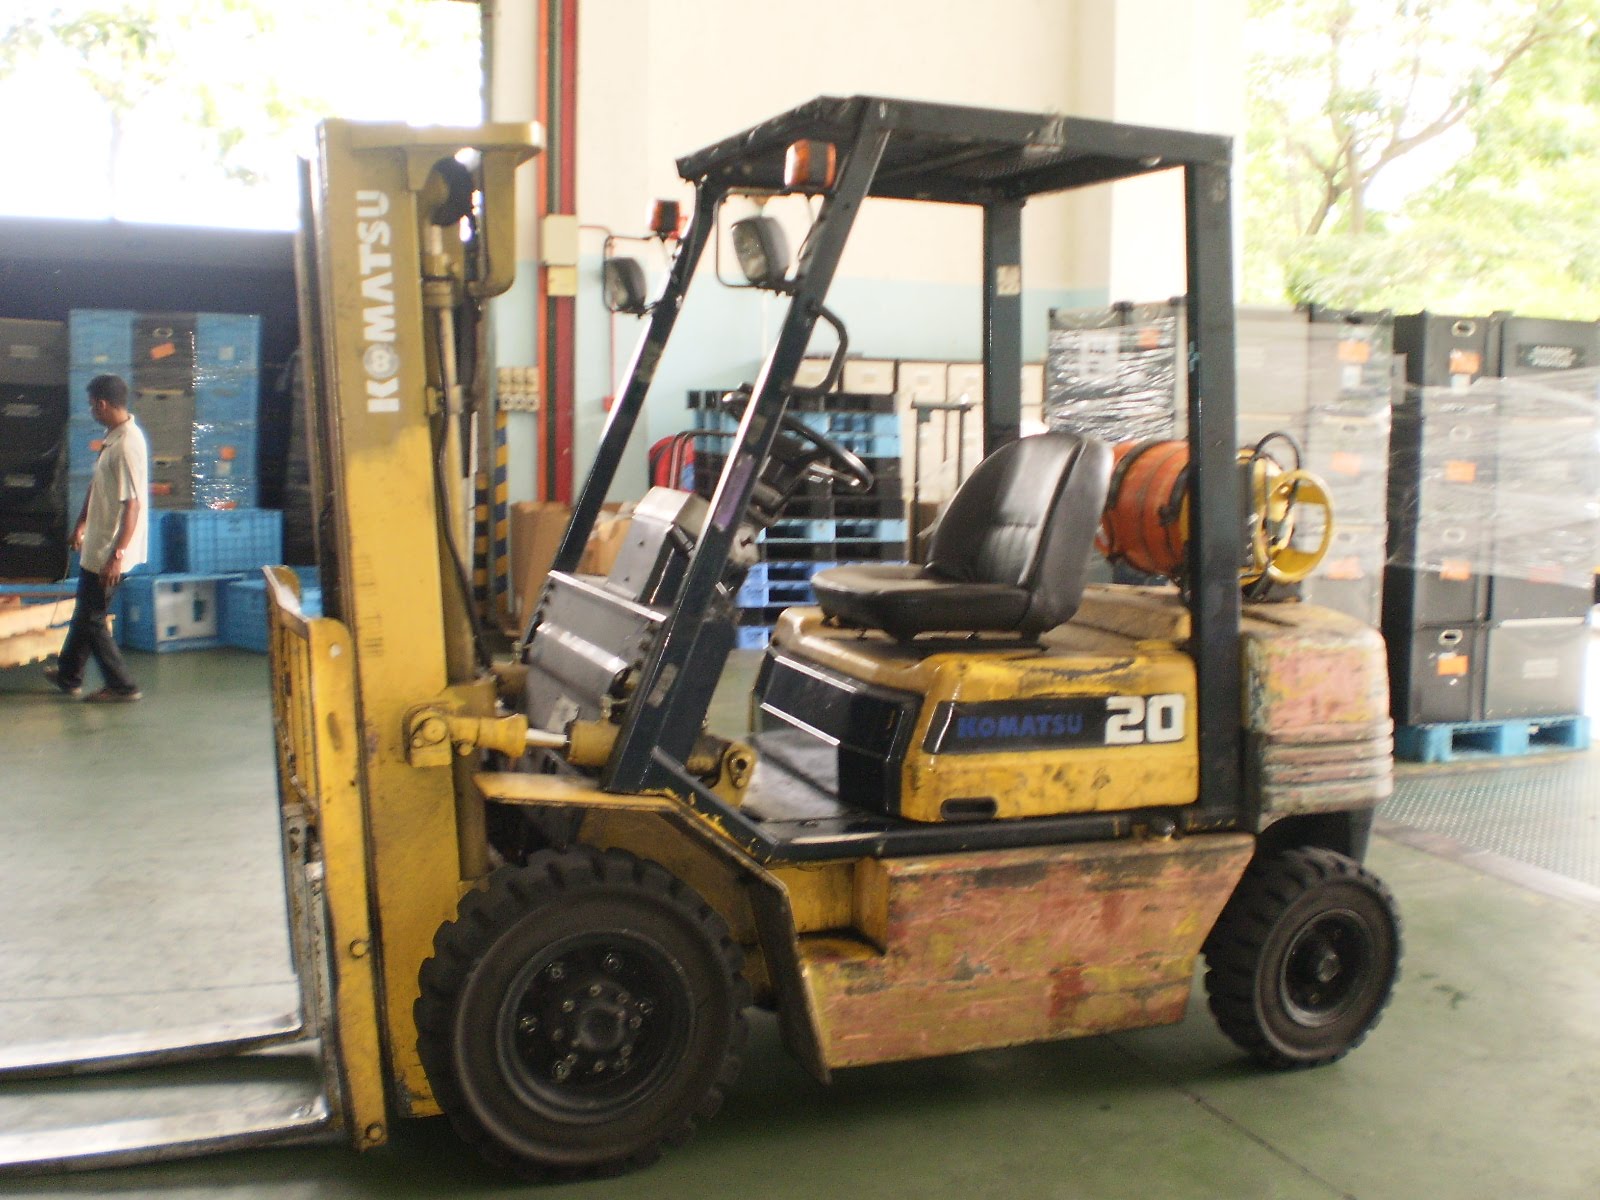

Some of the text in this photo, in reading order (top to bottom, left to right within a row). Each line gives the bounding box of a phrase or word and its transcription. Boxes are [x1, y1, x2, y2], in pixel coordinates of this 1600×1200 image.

[356, 190, 400, 413] KOMATSU
[957, 694, 1185, 744] KOMATSU 20
